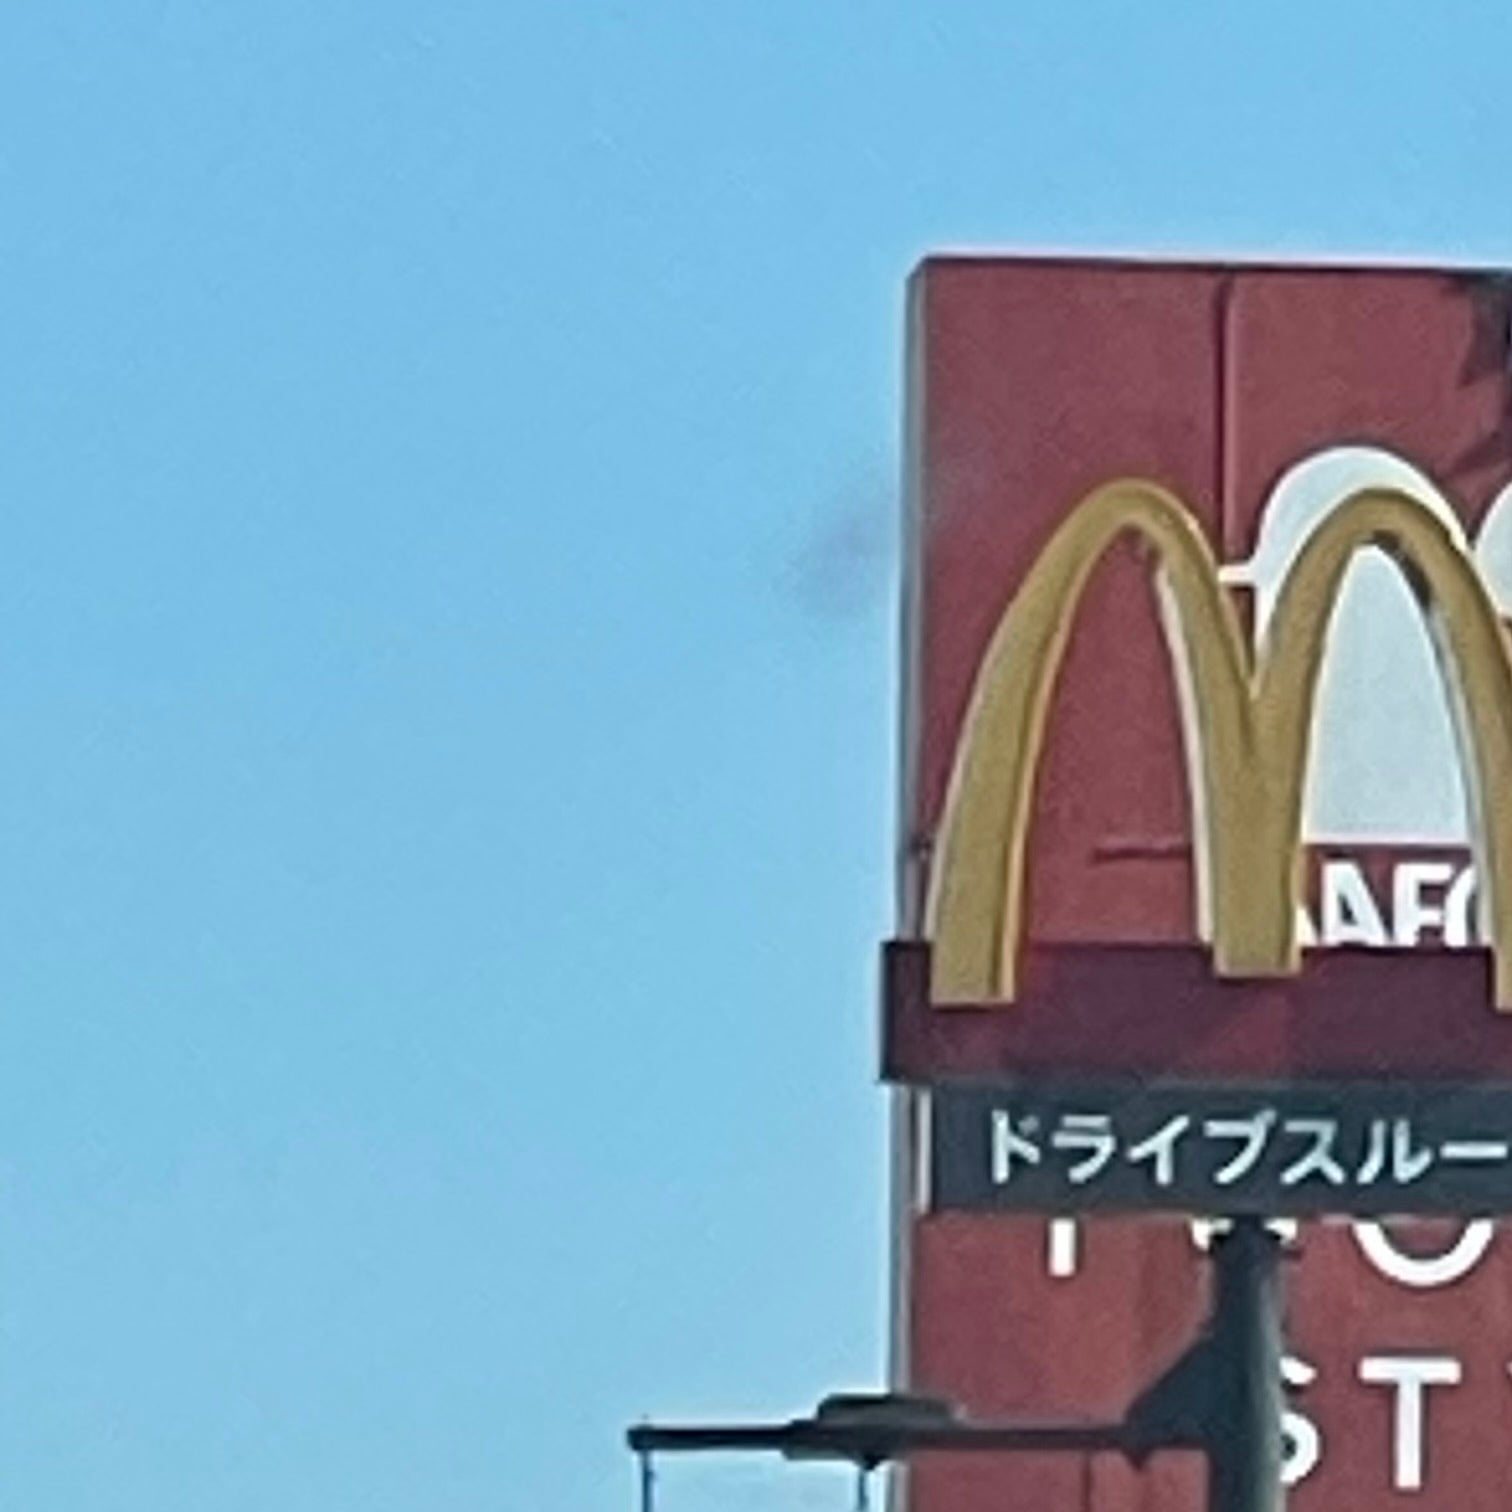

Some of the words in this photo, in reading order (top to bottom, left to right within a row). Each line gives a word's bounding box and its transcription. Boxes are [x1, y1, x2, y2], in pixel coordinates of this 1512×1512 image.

[990, 1108, 1509, 1185] ドライブスルー
